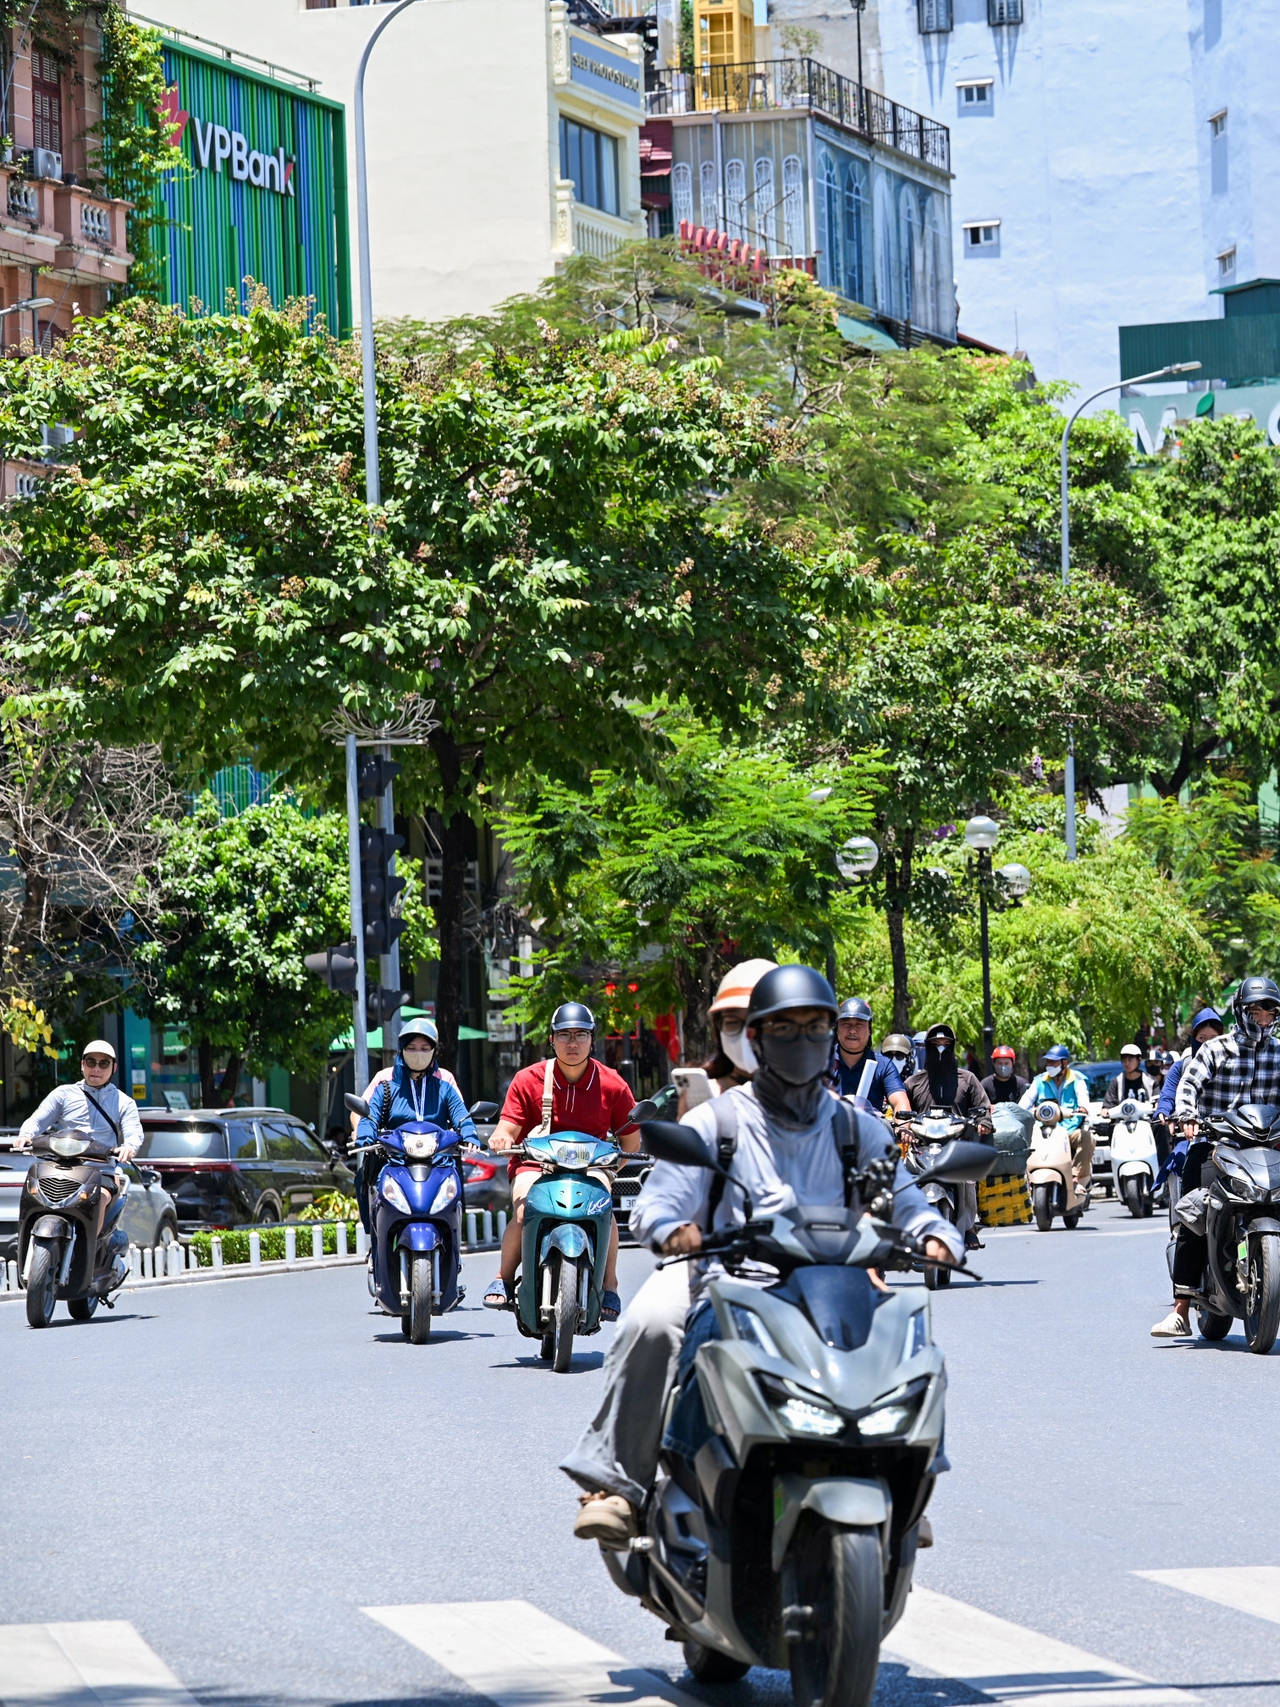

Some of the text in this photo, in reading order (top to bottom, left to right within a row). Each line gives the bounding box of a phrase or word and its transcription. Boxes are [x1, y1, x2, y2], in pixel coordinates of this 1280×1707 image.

[590, 61, 615, 80] PHOTO
[614, 70, 640, 92] STUDIO
[191, 116, 296, 197] VPBank
